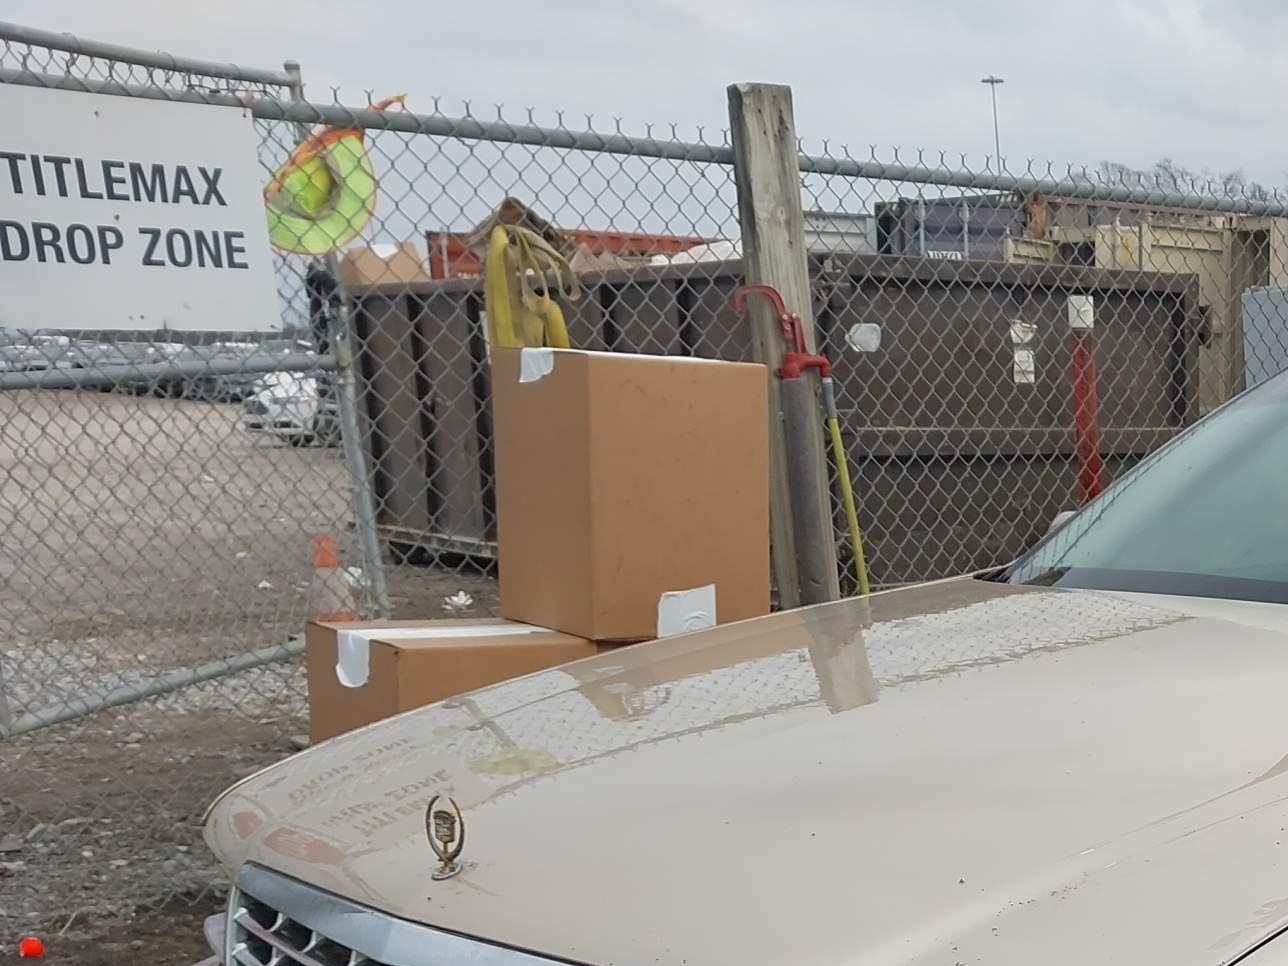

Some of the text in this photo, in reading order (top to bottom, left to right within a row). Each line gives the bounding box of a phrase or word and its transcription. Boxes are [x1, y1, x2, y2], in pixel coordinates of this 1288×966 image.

[0, 151, 228, 206] TITLEMAX
[0, 220, 249, 269] DROP ZONE
